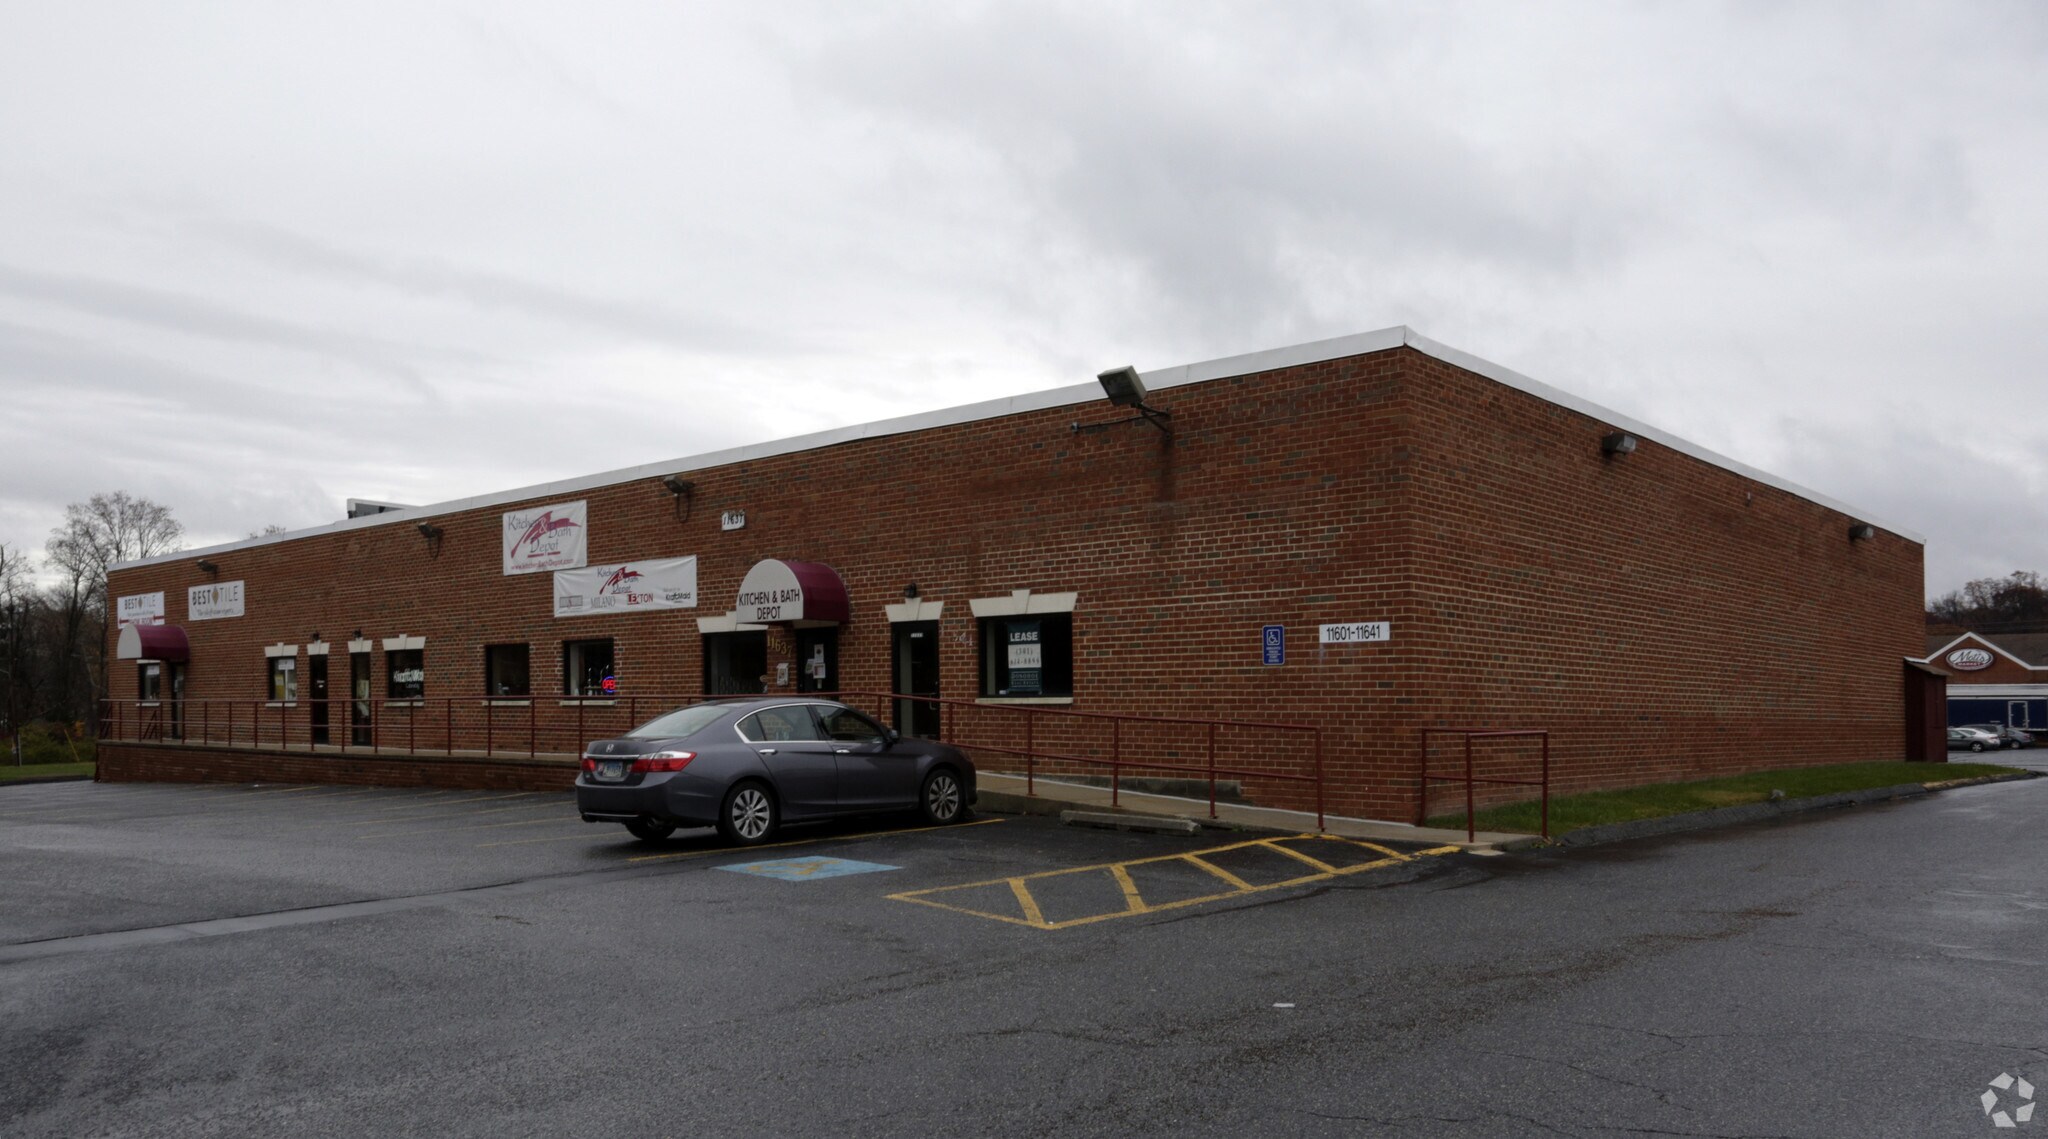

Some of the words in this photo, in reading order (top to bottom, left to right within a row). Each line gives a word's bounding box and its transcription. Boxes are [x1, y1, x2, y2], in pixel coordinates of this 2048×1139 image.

[530, 537, 559, 555] Depot
[124, 597, 138, 610] BEST
[143, 594, 156, 608] TILE
[192, 589, 211, 606] BEST
[219, 584, 239, 603] TILE
[738, 591, 770, 606] KITCHEN
[772, 590, 778, 604] &
[780, 588, 800, 603] BATH
[757, 606, 781, 620] DEPOT
[1010, 631, 1038, 641] LEASE
[1327, 624, 1380, 641] 11601-11641
[768, 635, 792, 658] 11637
[602, 679, 615, 690] OPE
